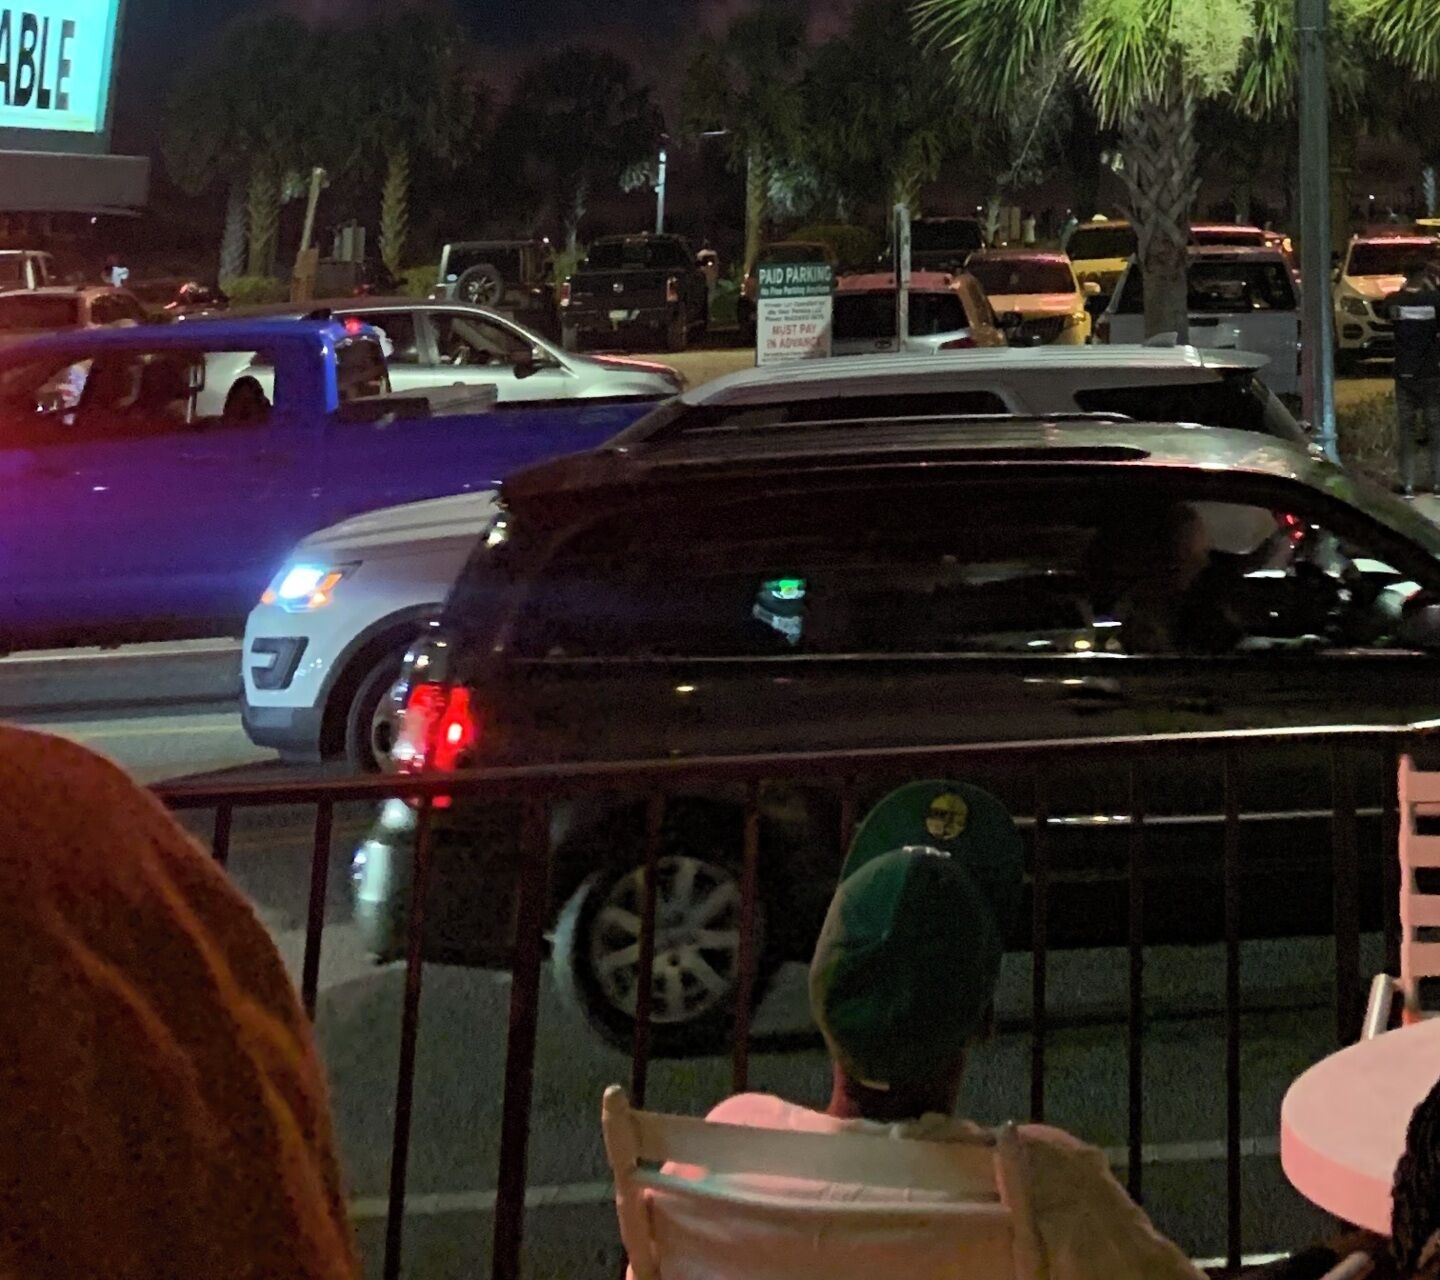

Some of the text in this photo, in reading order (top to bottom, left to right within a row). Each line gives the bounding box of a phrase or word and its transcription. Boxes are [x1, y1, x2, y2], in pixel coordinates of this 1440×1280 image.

[759, 265, 832, 285] PAID PARKING
[772, 323, 817, 335] MUST PAY
